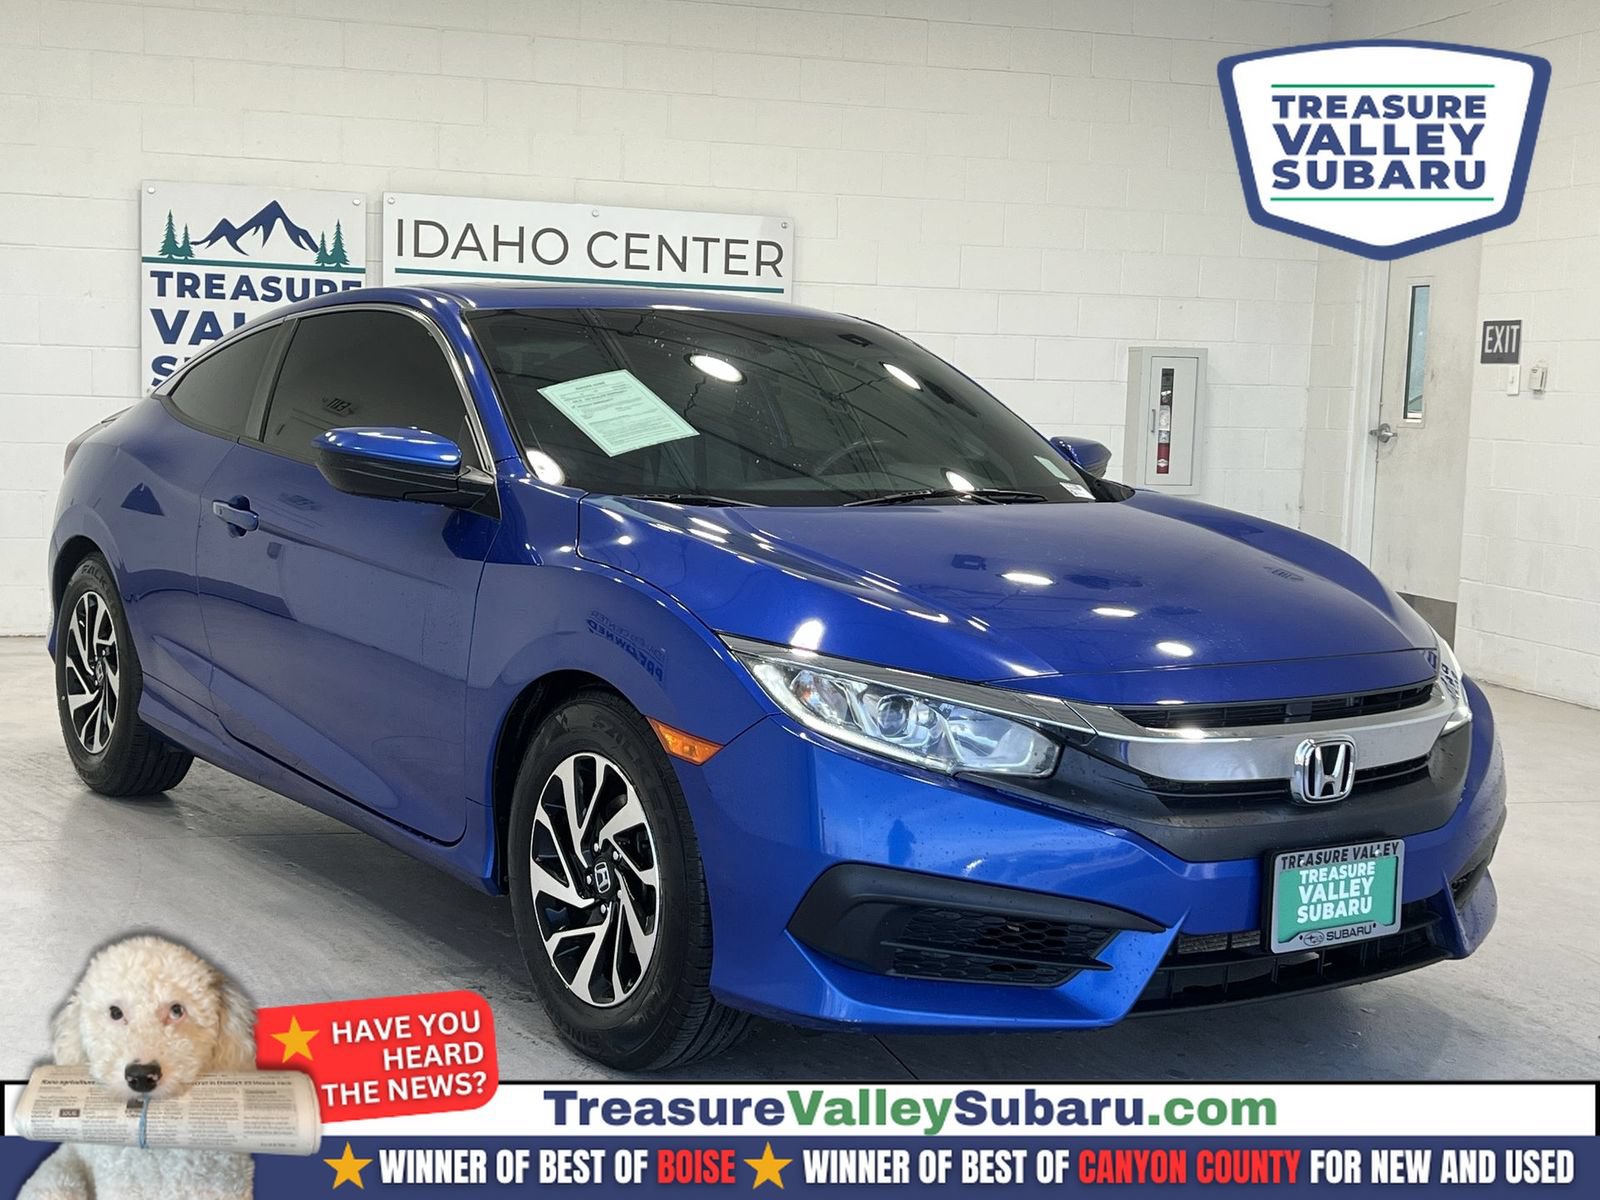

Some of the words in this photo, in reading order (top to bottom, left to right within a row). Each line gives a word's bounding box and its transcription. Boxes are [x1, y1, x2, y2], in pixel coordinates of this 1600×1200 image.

[397, 218, 569, 265] IDAHO
[587, 230, 783, 278] CENTER
[1484, 325, 1520, 353] EXIT
[1281, 848, 1348, 870] TREASURE
[1353, 841, 1400, 861] VALLEY
[1298, 861, 1376, 885] TREASURE
[1298, 876, 1375, 904] VALLEY
[1296, 896, 1373, 924] SUBARU
[1326, 925, 1372, 941] SUBARU
